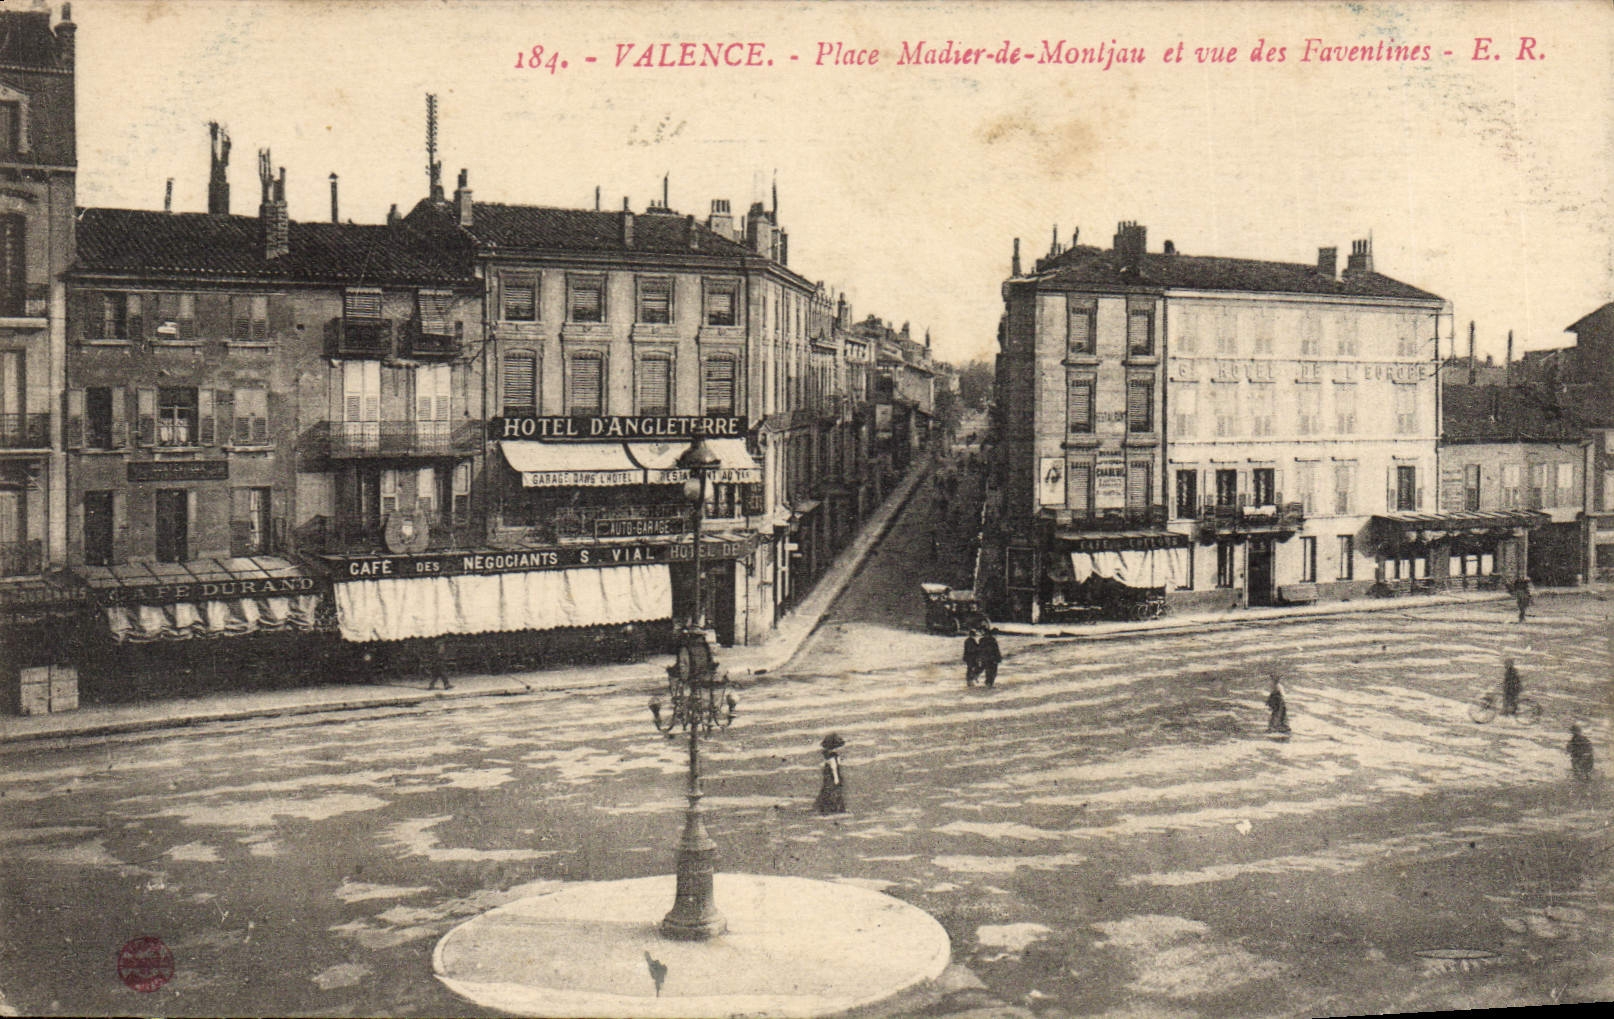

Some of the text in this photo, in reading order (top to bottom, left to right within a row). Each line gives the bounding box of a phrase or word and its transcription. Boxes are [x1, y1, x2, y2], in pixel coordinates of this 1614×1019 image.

[502, 416, 740, 437] HOTEL D'ANGLETERRE
[532, 472, 569, 485] GARAGE
[660, 470, 716, 482] RESTANT
[610, 520, 670, 535] AUTO-GARAGE
[416, 561, 440, 573] DES
[611, 547, 655, 562] VIAL
[202, 577, 315, 597] DURAND
